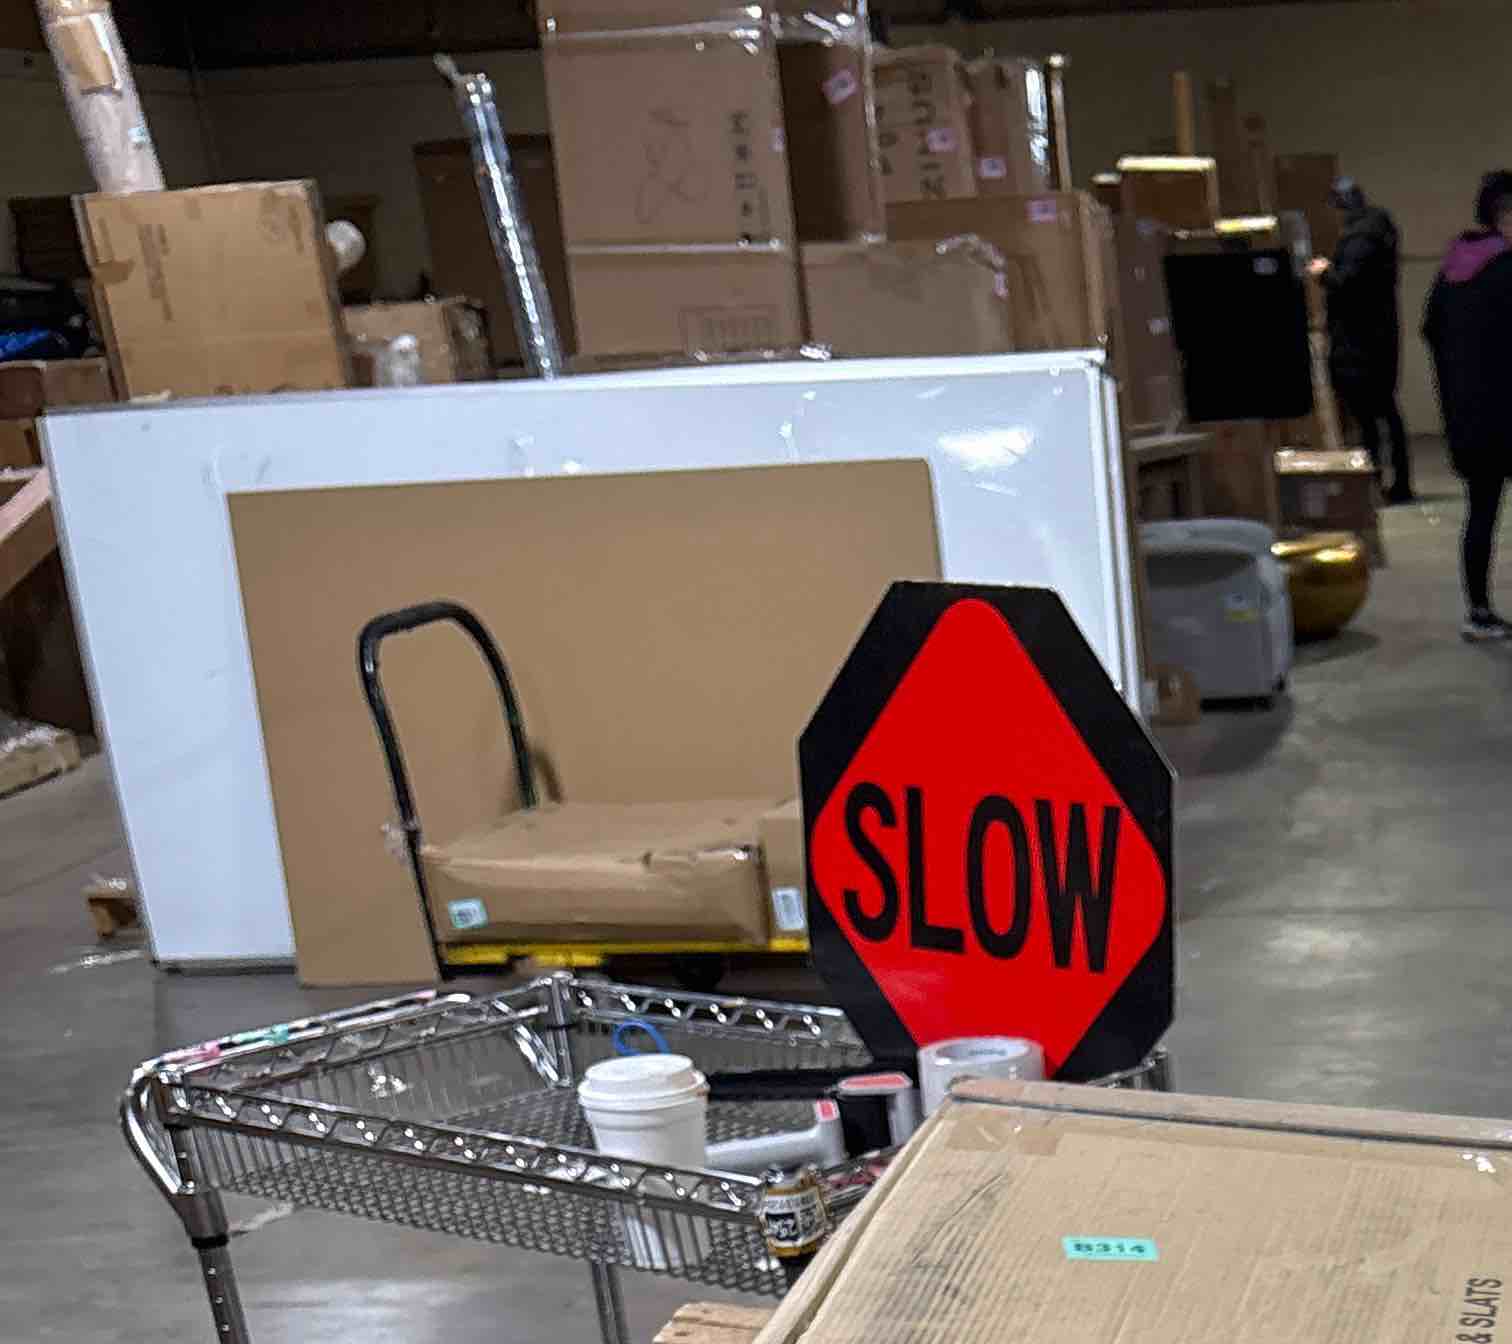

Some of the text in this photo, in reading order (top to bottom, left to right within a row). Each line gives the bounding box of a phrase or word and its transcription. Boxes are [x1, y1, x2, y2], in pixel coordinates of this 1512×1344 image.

[843, 781, 1121, 974] SLOW
[1459, 1278, 1503, 1329] SLATS
[1456, 1333, 1493, 1344] &
